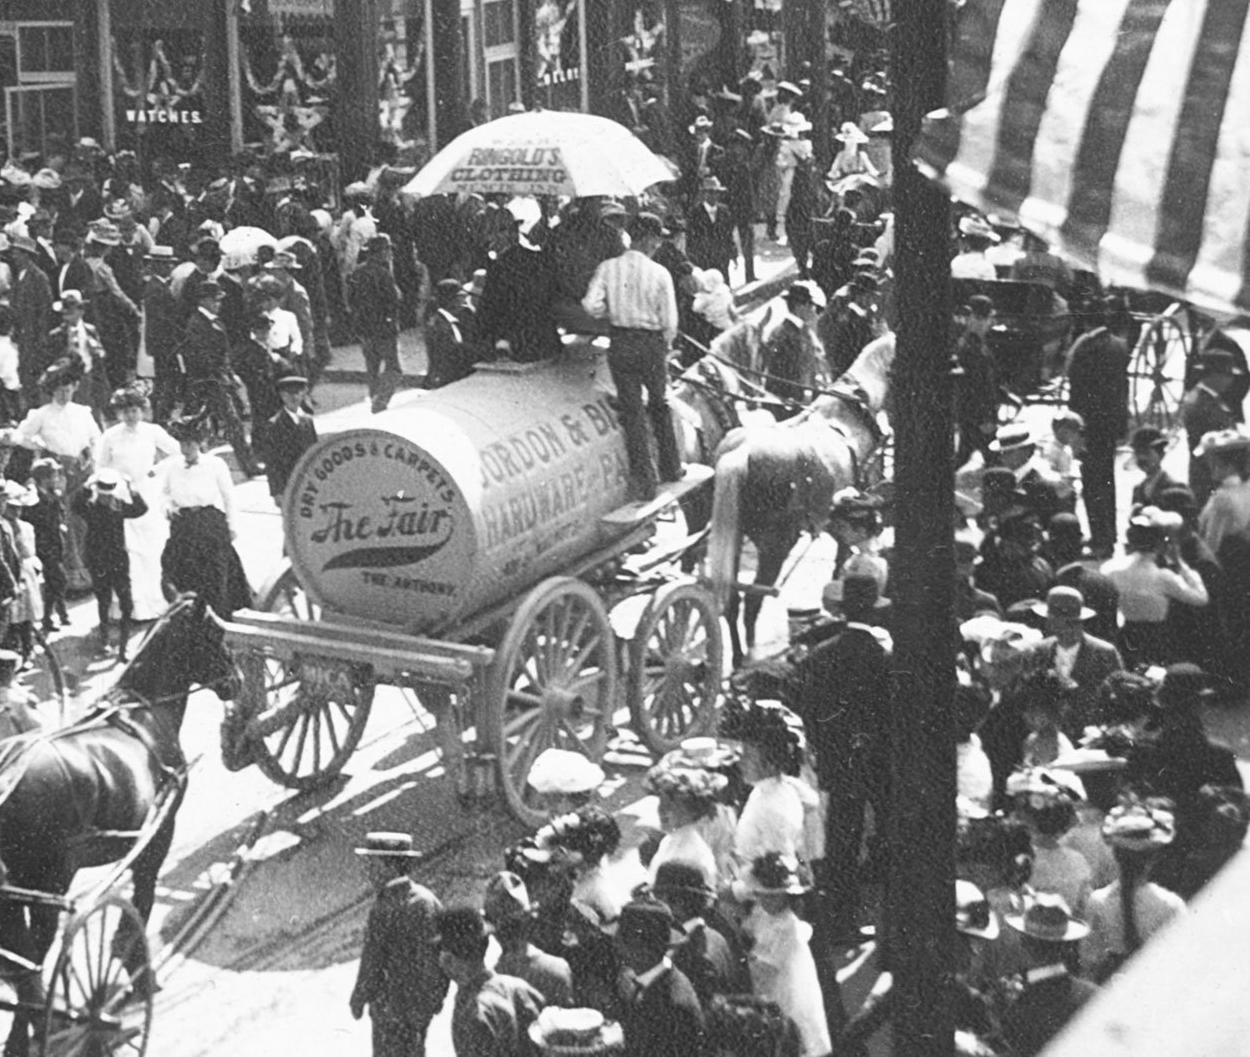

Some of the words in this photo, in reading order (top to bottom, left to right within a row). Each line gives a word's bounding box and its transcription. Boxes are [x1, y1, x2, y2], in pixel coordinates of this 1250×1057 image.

[450, 168, 568, 183] CLOTHING
[559, 413, 589, 446] &
[299, 481, 320, 519] DRY
[315, 443, 367, 481] GOODS
[310, 501, 374, 543] The
[376, 494, 454, 537] Fair
[361, 571, 388, 587] THE
